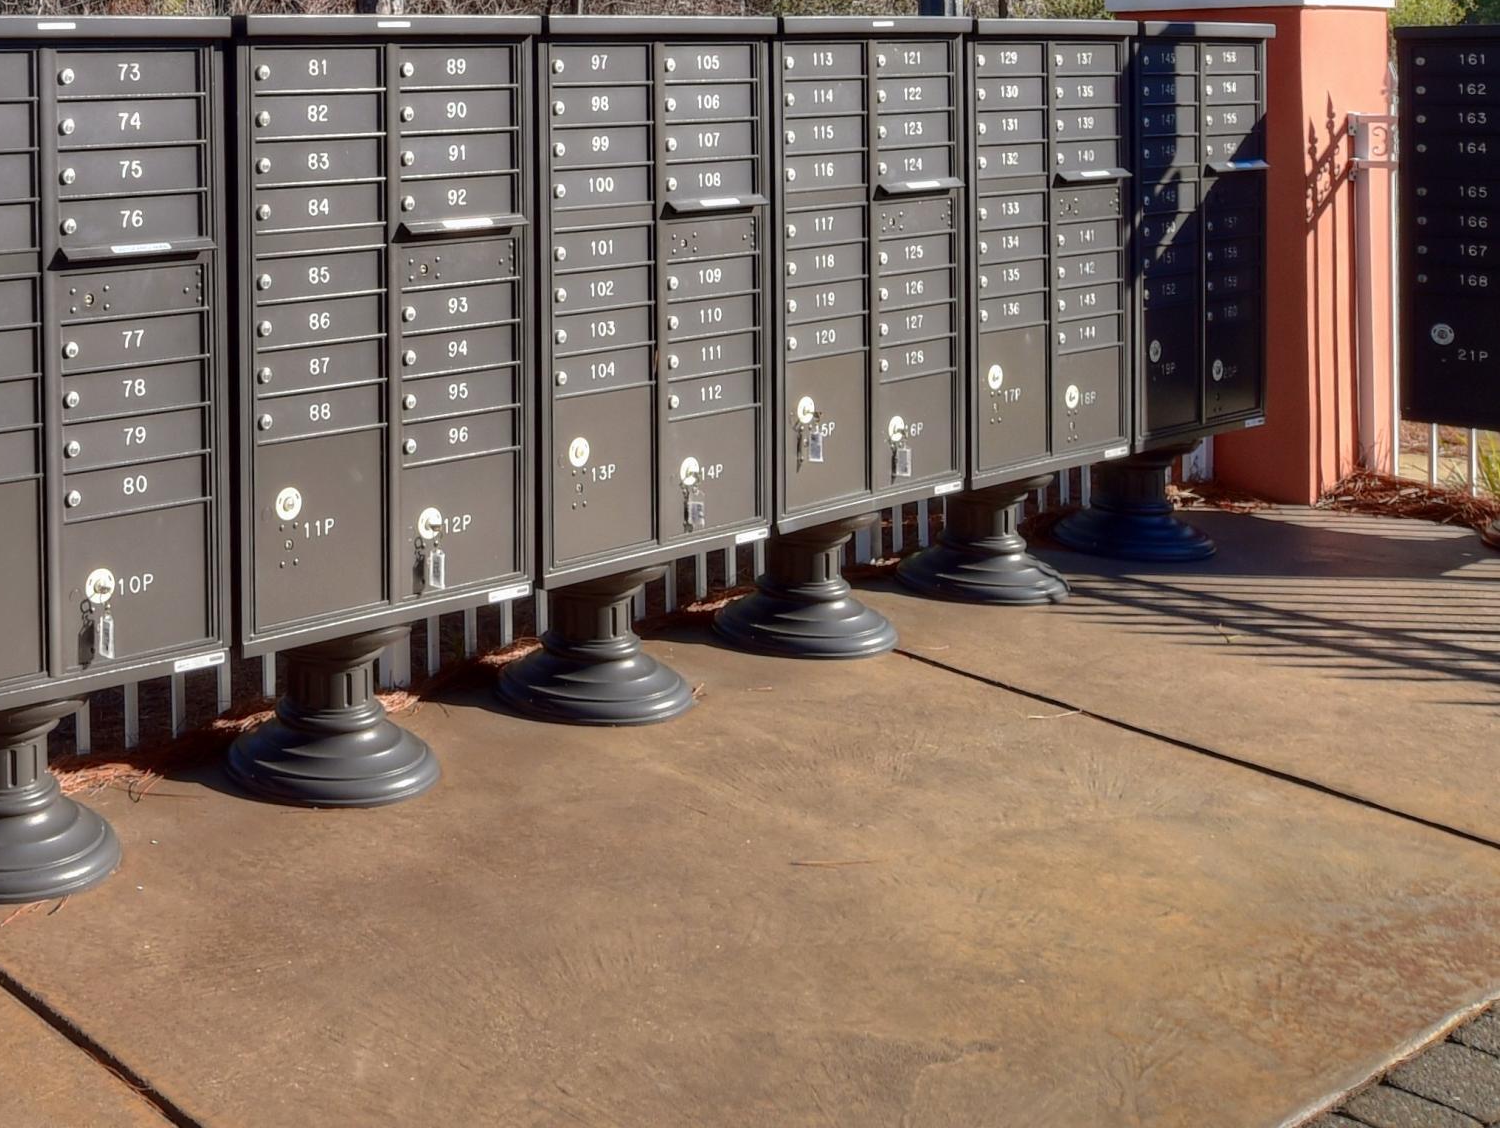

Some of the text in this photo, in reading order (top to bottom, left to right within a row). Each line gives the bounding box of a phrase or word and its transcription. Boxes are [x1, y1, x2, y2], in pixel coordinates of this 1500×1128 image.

[592, 55, 607, 70] 97
[697, 55, 719, 69] 105
[814, 52, 832, 65] 113
[904, 52, 920, 64] 121
[1001, 52, 1017, 64] 129
[1077, 53, 1092, 64] 137
[1460, 54, 1484, 65] 161
[118, 63, 140, 80] 73
[309, 59, 326, 75] 81
[447, 59, 466, 74] 89
[814, 89, 833, 102] 114
[904, 87, 921, 100] 122
[1001, 86, 1018, 97] 130
[1459, 84, 1486, 94] 162
[592, 96, 609, 111] 98
[698, 95, 719, 109] 106
[308, 105, 327, 122] 82
[447, 102, 466, 118] 90
[119, 112, 141, 130] 74
[1003, 119, 1017, 130] 131
[1078, 117, 1094, 128] 139
[1459, 113, 1486, 123] 163
[814, 126, 833, 139] 115
[905, 122, 922, 135] 123
[592, 136, 609, 151] 99
[699, 133, 719, 147] 107
[1459, 142, 1486, 153] 164
[449, 145, 465, 161] 91
[1002, 152, 1018, 165] 132
[1078, 150, 1094, 161] 140
[308, 153, 329, 169] 83
[905, 158, 922, 171] 124
[120, 161, 142, 178] 75
[815, 163, 833, 176] 116
[589, 177, 614, 192] 100
[699, 172, 720, 187] 108
[448, 189, 466, 205] 92
[1460, 186, 1487, 198] 165
[309, 199, 329, 216] 84
[1002, 202, 1019, 214] 133
[121, 210, 143, 227] 76
[815, 217, 833, 231] 117
[1460, 216, 1487, 228] 166
[1003, 236, 1018, 248] 134
[1080, 230, 1094, 241] 141
[592, 240, 612, 255] 101
[905, 245, 923, 259] 125
[1461, 245, 1487, 256] 167
[816, 254, 834, 268] 118
[1080, 262, 1094, 274] 142
[309, 267, 329, 284] 85
[699, 268, 721, 283] 109
[1003, 269, 1019, 281] 135
[1460, 275, 1487, 287] 168
[591, 281, 613, 296] 102
[906, 280, 923, 294] 126
[449, 297, 468, 313] 93
[816, 292, 835, 307] 119
[1080, 293, 1095, 306] 143
[701, 308, 722, 323] 110
[1004, 303, 1019, 315] 136
[310, 313, 330, 330] 86
[591, 321, 615, 337] 103
[906, 315, 923, 329] 127
[123, 330, 144, 348] 77
[816, 329, 835, 344] 120
[1080, 326, 1095, 339] 144
[449, 340, 467, 357] 94
[702, 345, 720, 361] 111
[1458, 349, 1488, 361] 21P
[310, 357, 329, 374] 87
[591, 362, 614, 378] 104
[123, 379, 145, 397] 78
[449, 383, 468, 399] 95
[702, 385, 721, 401] 112
[1005, 388, 1020, 402] 17P
[310, 403, 330, 421] 88
[124, 427, 146, 445] 79
[449, 427, 468, 444] 96
[592, 464, 615, 481] 13P
[701, 464, 722, 480] 14P
[124, 475, 147, 494] 80
[305, 519, 334, 538] 11P
[444, 515, 471, 533] 12P
[119, 574, 153, 595] 10P
